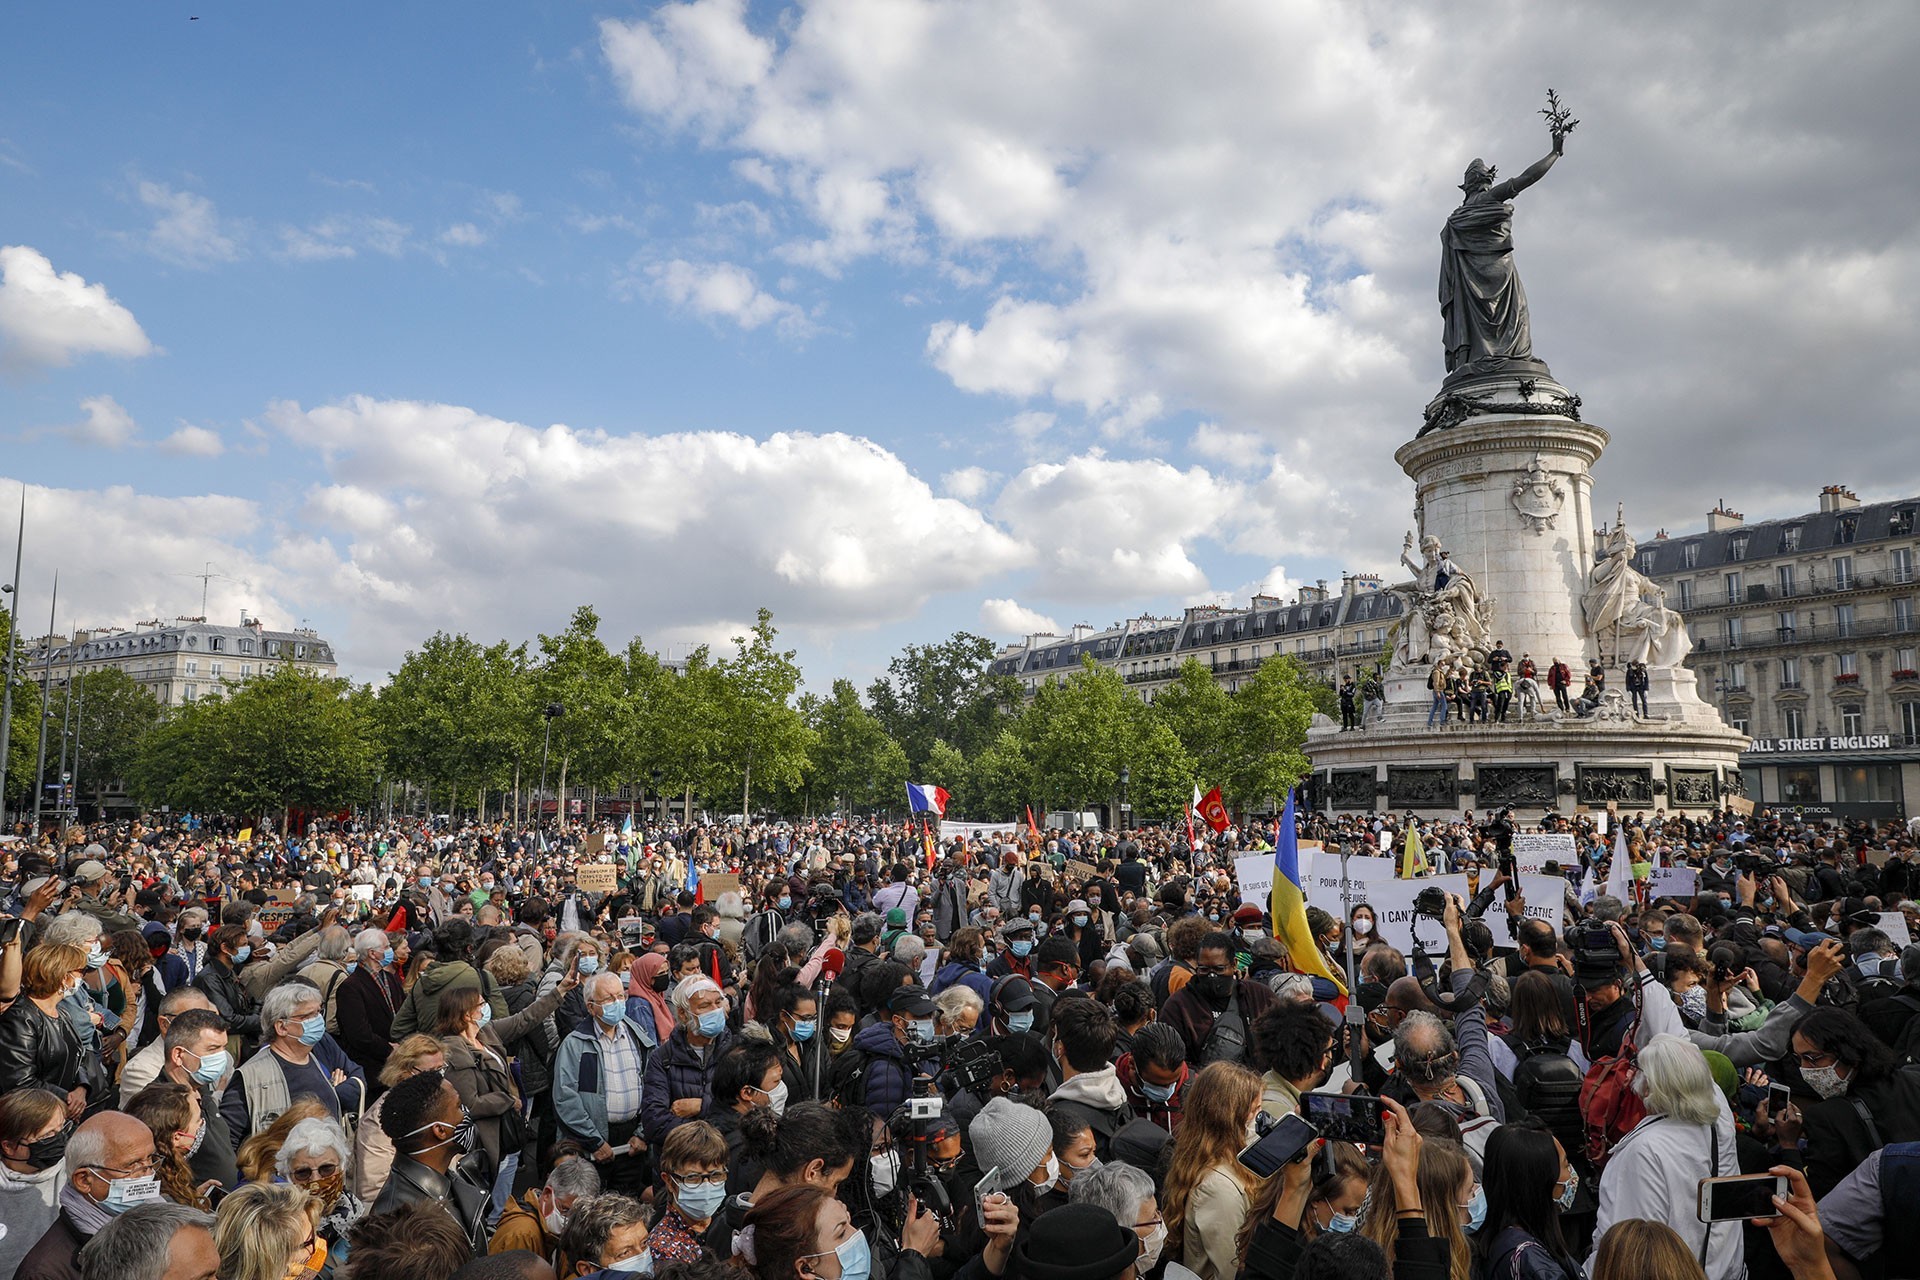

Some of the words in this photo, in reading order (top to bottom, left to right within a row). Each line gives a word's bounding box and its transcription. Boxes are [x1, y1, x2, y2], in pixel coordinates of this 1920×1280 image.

[1779, 738, 1825, 751] STREET
[1830, 735, 1890, 750] ENGLISH
[1320, 877, 1338, 888] POUR
[1339, 879, 1352, 888] UE
[1354, 880, 1366, 890] POL
[1340, 893, 1367, 903] PEJUGE
[1381, 911, 1386, 923] I
[1578, 1002, 1587, 1027] Canon
